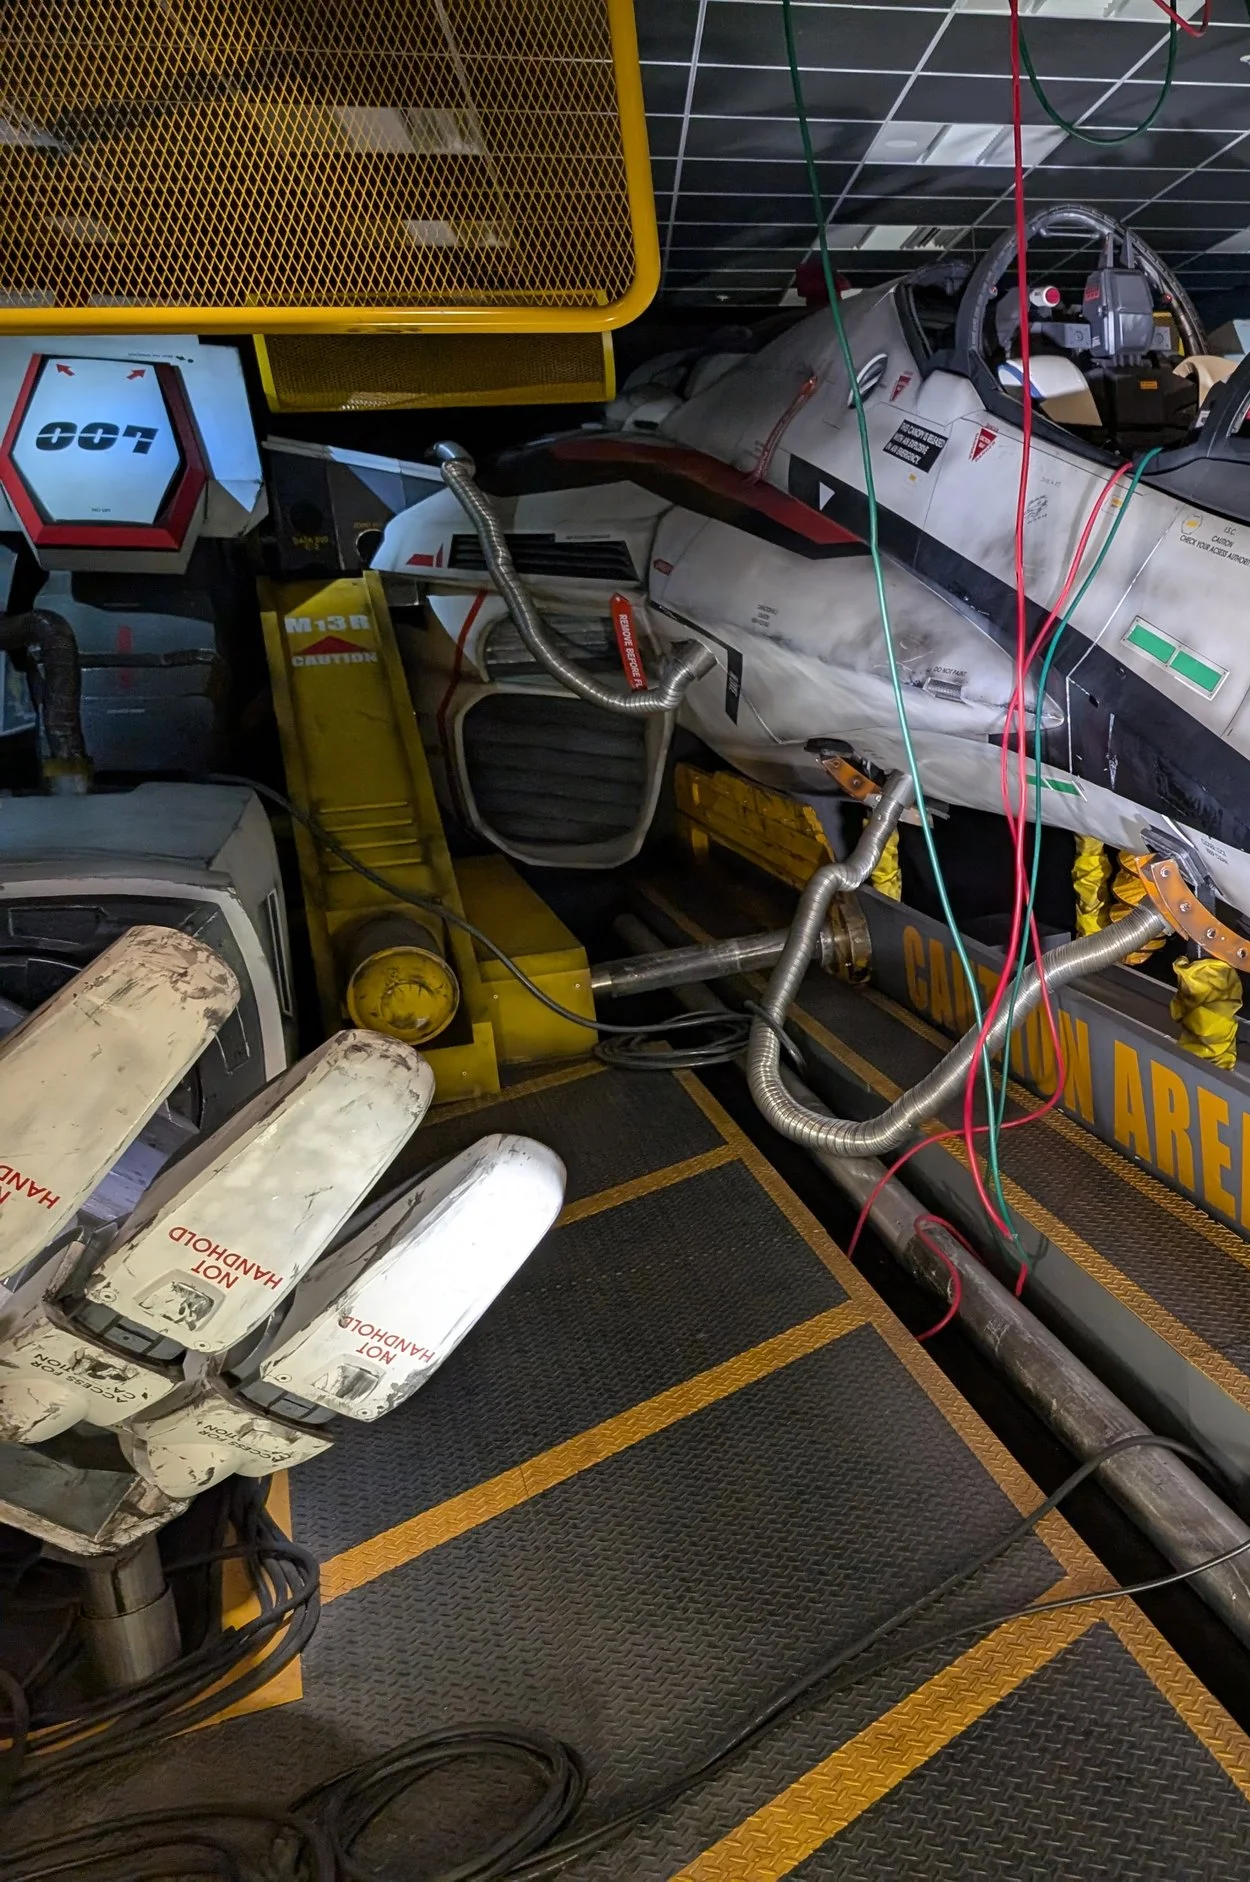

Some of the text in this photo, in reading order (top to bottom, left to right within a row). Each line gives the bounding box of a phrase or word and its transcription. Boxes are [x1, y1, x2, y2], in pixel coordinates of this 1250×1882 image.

[35, 421, 159, 455] 007
[1180, 535, 1197, 546] CHECK
[1196, 541, 1211, 551] YOUR
[1211, 535, 1234, 548] CAUTION
[619, 614, 634, 647] REMOVE
[292, 652, 378, 667] CAUTION
[626, 648, 641, 678] BEFORE
[903, 925, 1095, 1126] CAUON
[168, 1226, 284, 1291] HANDHOLD
[191, 1259, 240, 1290] NOT
[356, 1341, 398, 1366] NOT
[30, 1360, 129, 1404] ACCESS FOR
[197, 1430, 284, 1463] ACCESS FOR
